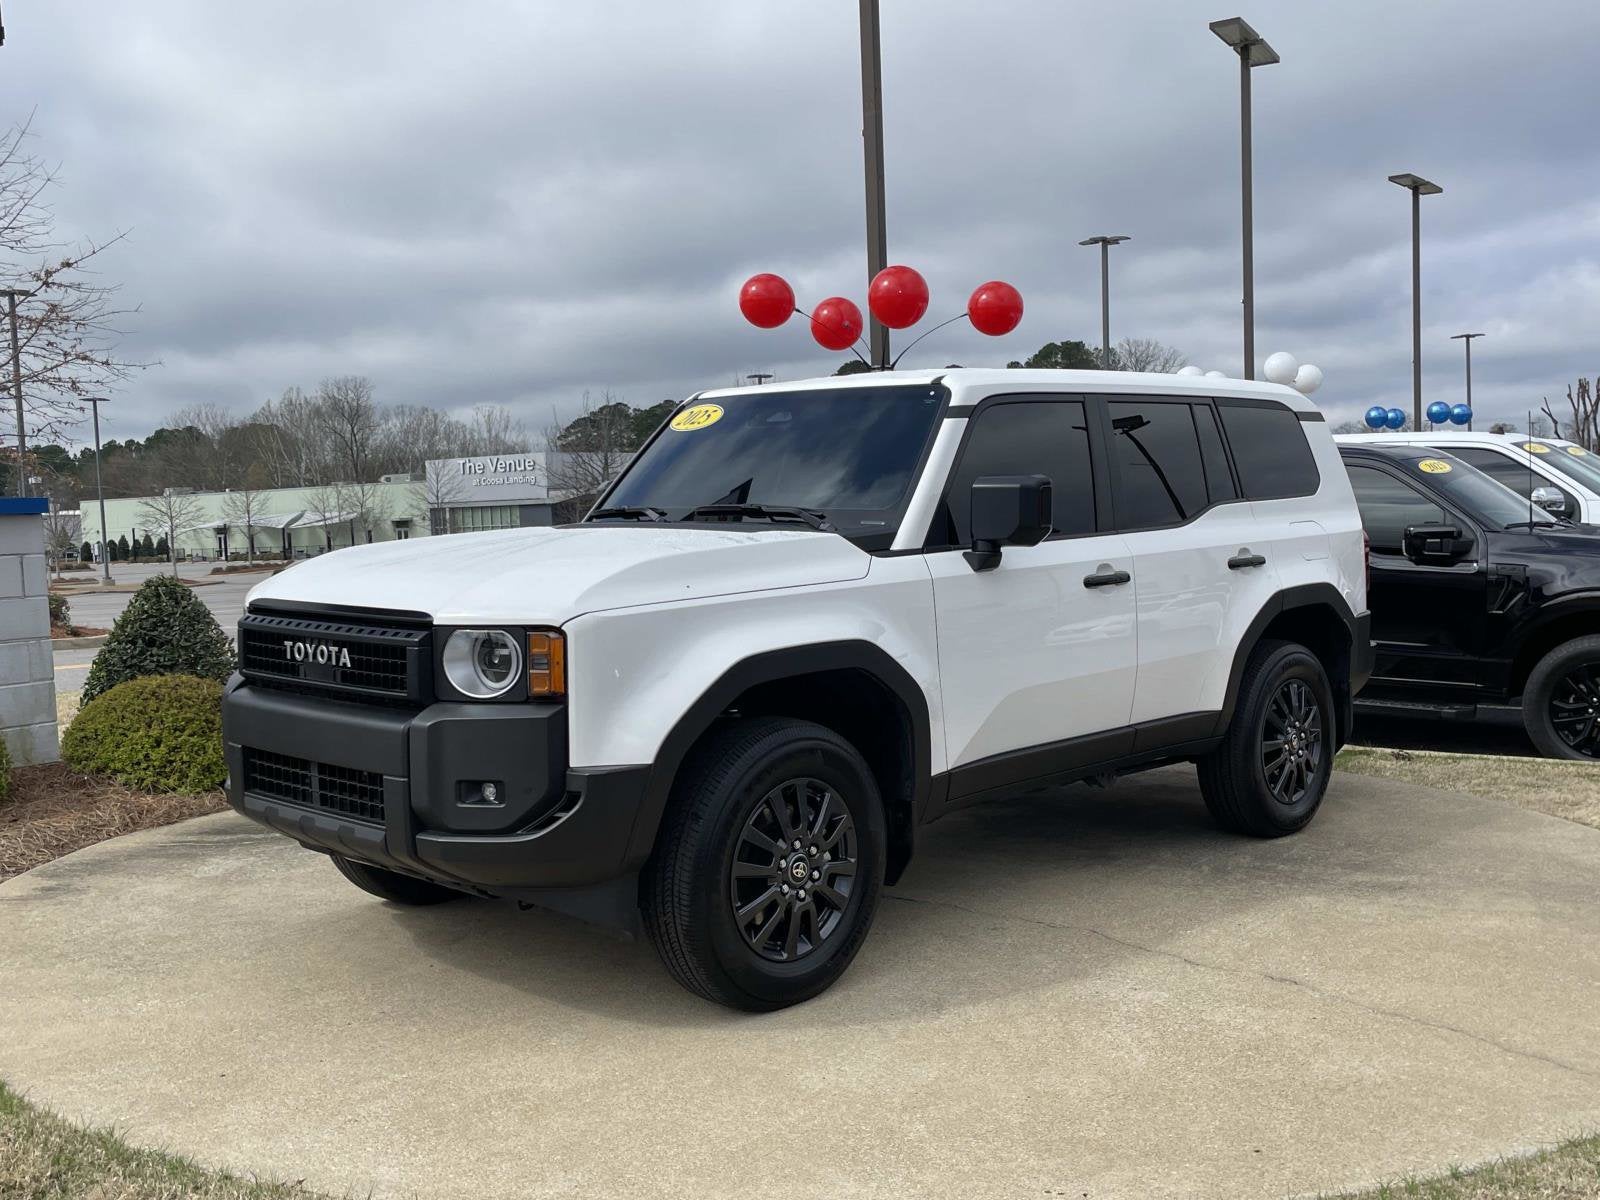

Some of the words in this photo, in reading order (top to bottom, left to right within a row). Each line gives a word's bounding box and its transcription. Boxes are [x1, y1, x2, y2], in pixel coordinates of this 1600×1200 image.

[674, 409, 719, 426] 2025
[457, 459, 485, 475] The
[488, 457, 535, 473] Venue
[472, 478, 481, 486] at
[482, 477, 504, 486] Coosa
[505, 475, 536, 486] Landing
[284, 641, 351, 667] TOYOTA
